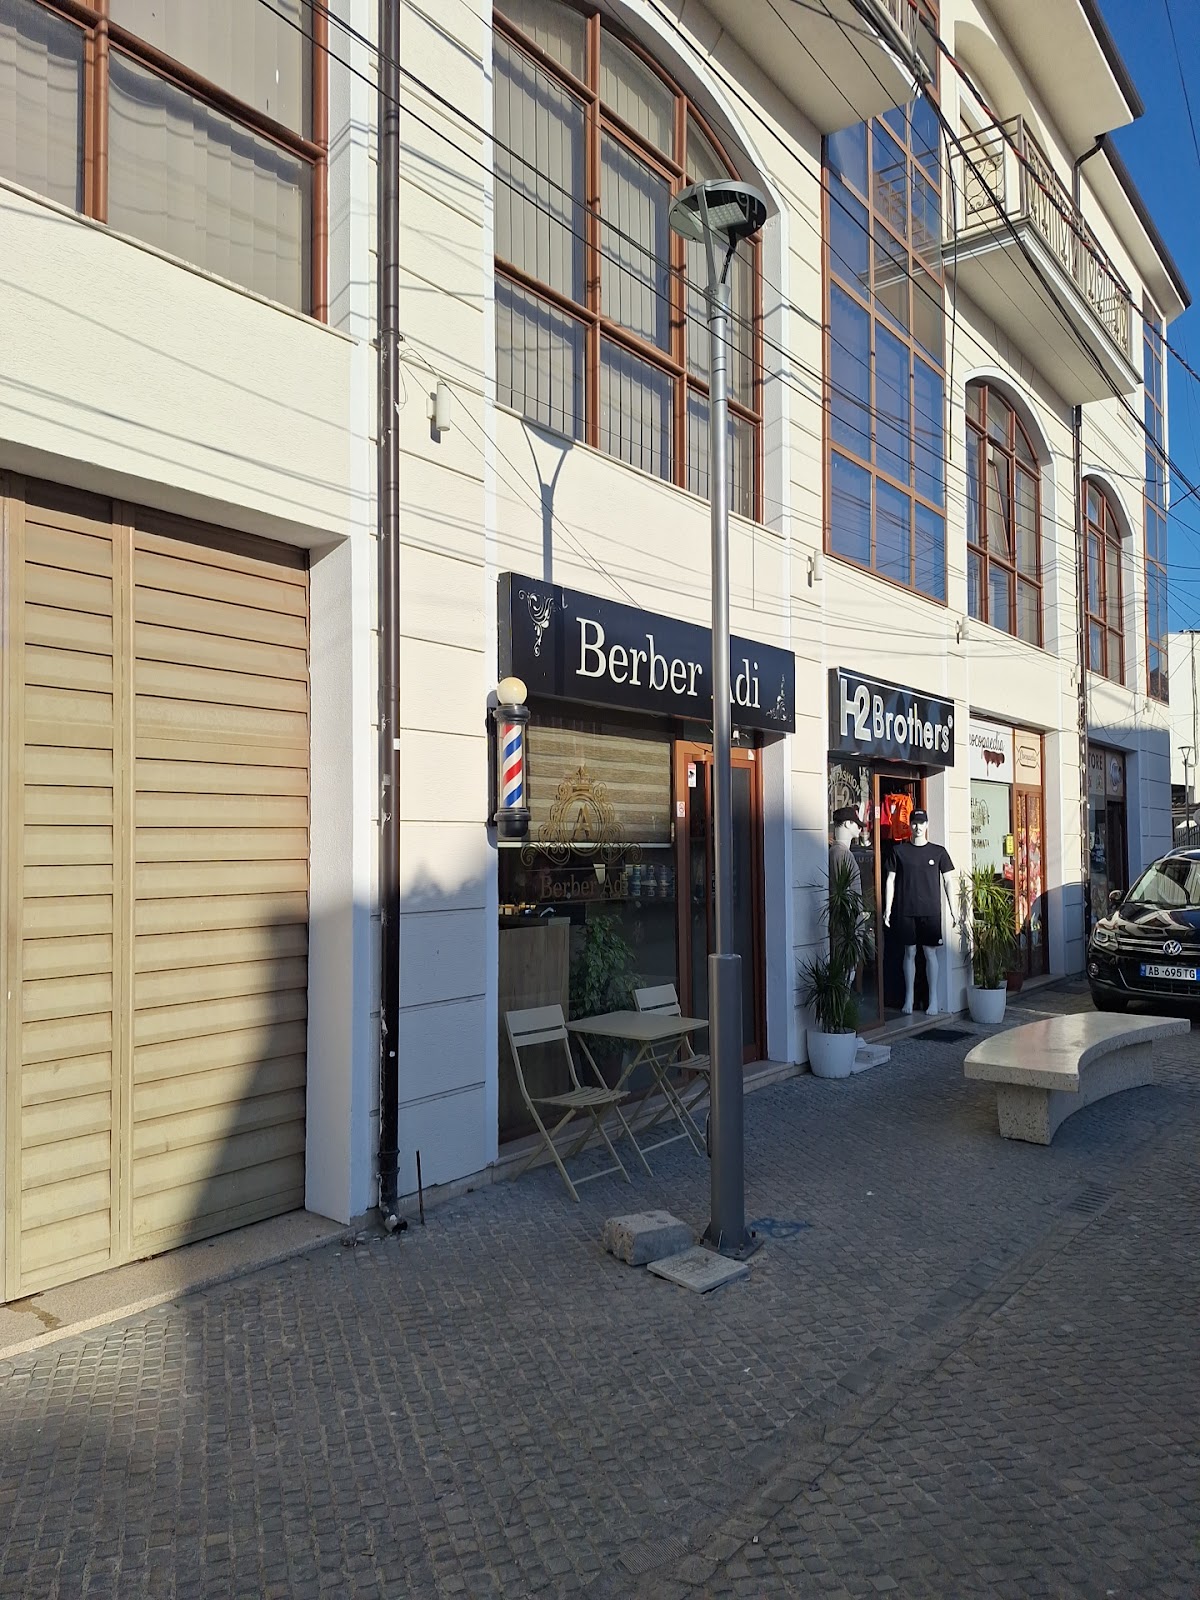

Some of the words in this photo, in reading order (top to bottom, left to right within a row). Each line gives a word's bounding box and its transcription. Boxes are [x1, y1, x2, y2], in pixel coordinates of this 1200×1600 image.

[575, 616, 703, 697] Berber
[711, 658, 761, 709] di
[572, 803, 597, 841] A
[540, 872, 597, 899] Berber
